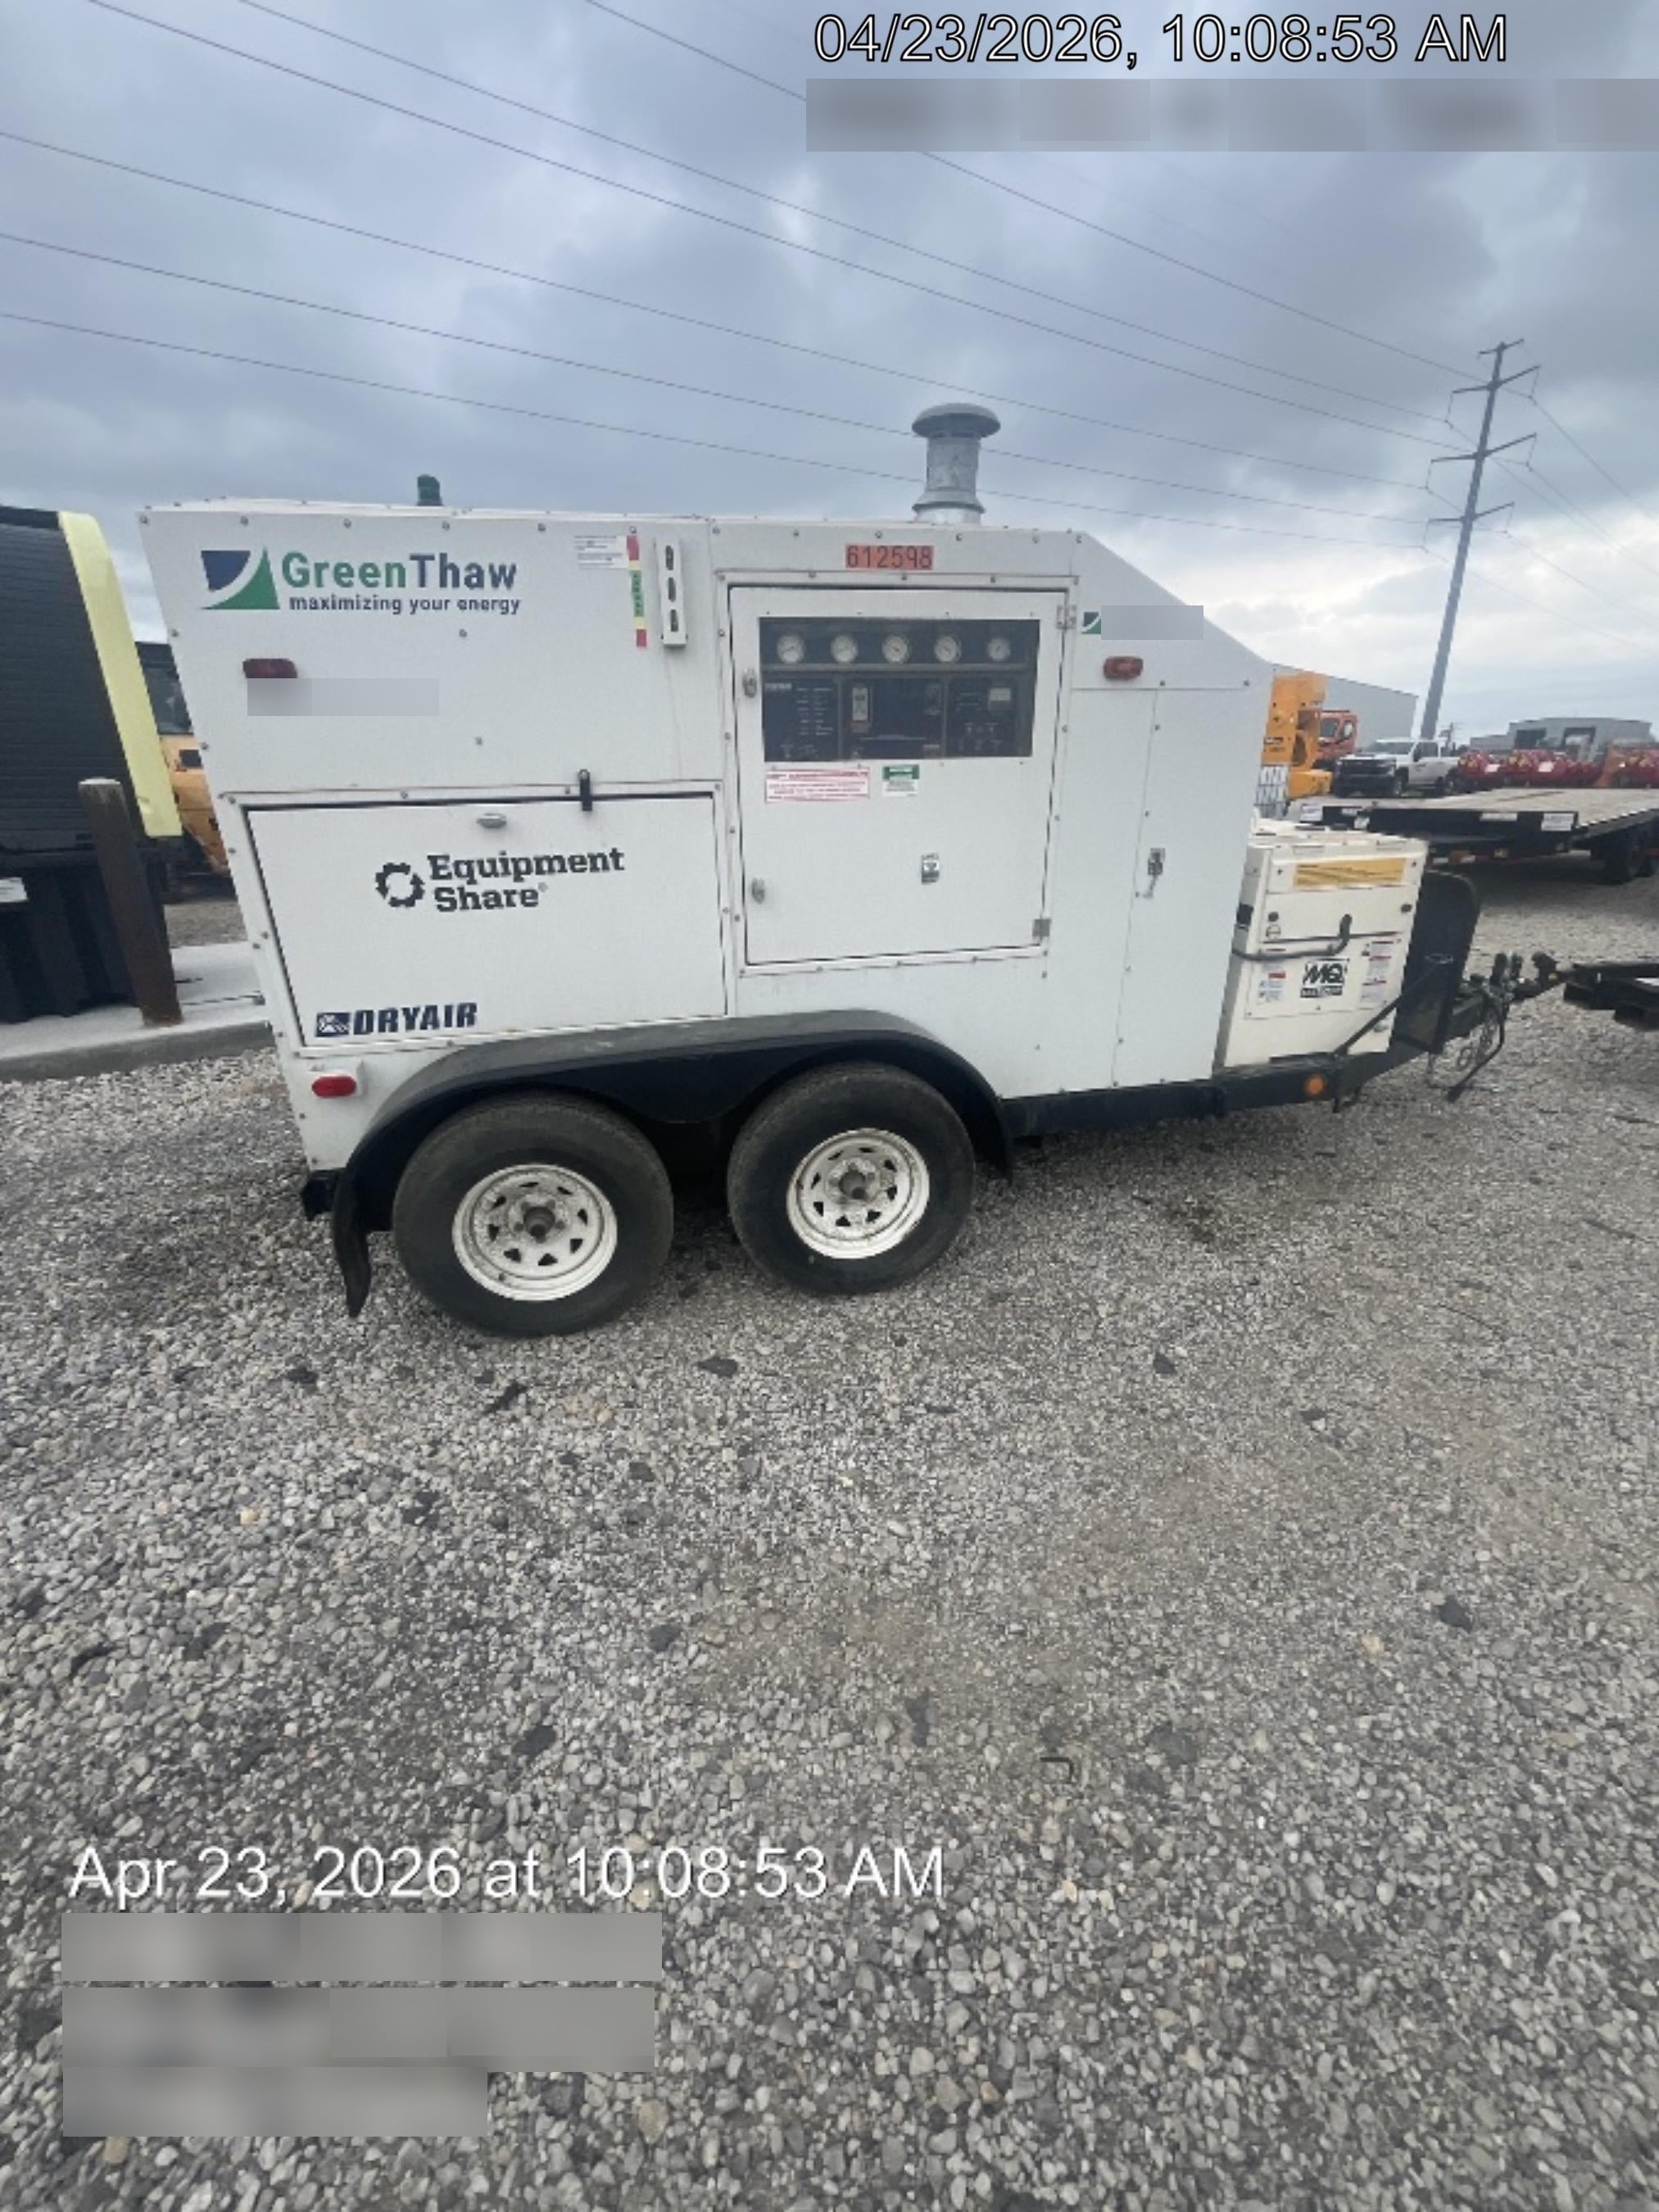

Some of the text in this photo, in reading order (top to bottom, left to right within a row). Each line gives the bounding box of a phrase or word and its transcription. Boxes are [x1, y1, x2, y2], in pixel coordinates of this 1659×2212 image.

[281, 551, 518, 591] GreenThaw
[846, 545, 933, 569] 612598
[288, 593, 521, 615] maximizing your energy
[427, 847, 625, 886] Equipment
[353, 1001, 478, 1036] DRYAIR
